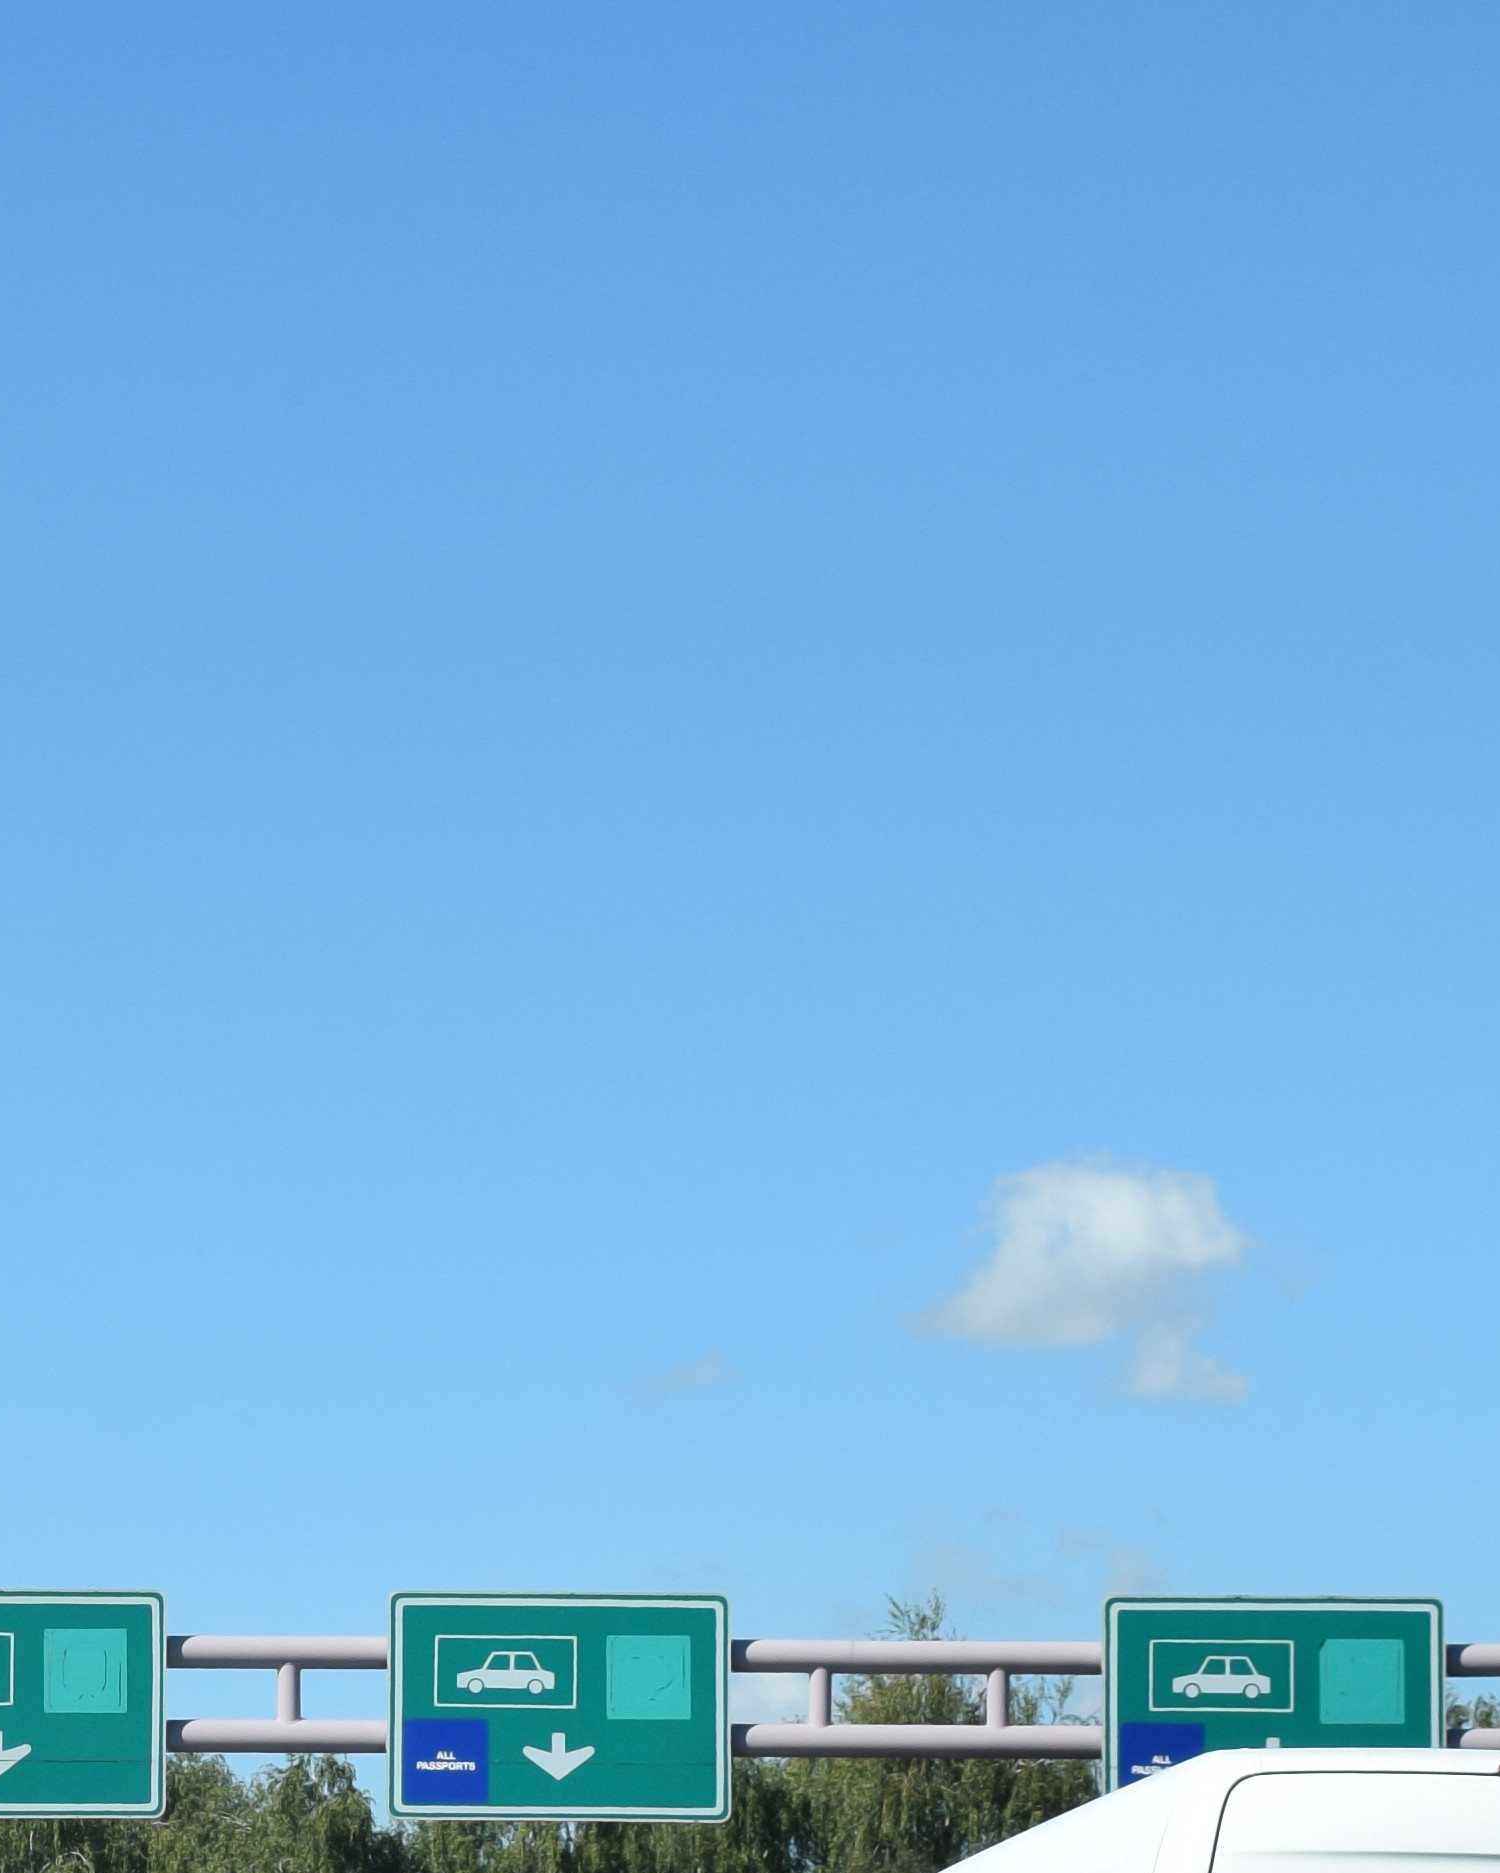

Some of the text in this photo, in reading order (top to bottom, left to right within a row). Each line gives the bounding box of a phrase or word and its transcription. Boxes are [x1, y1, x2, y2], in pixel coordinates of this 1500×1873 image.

[436, 1750, 456, 1760] ALL
[1151, 1755, 1172, 1765] ALL
[416, 1761, 476, 1771] PASSPORTS
